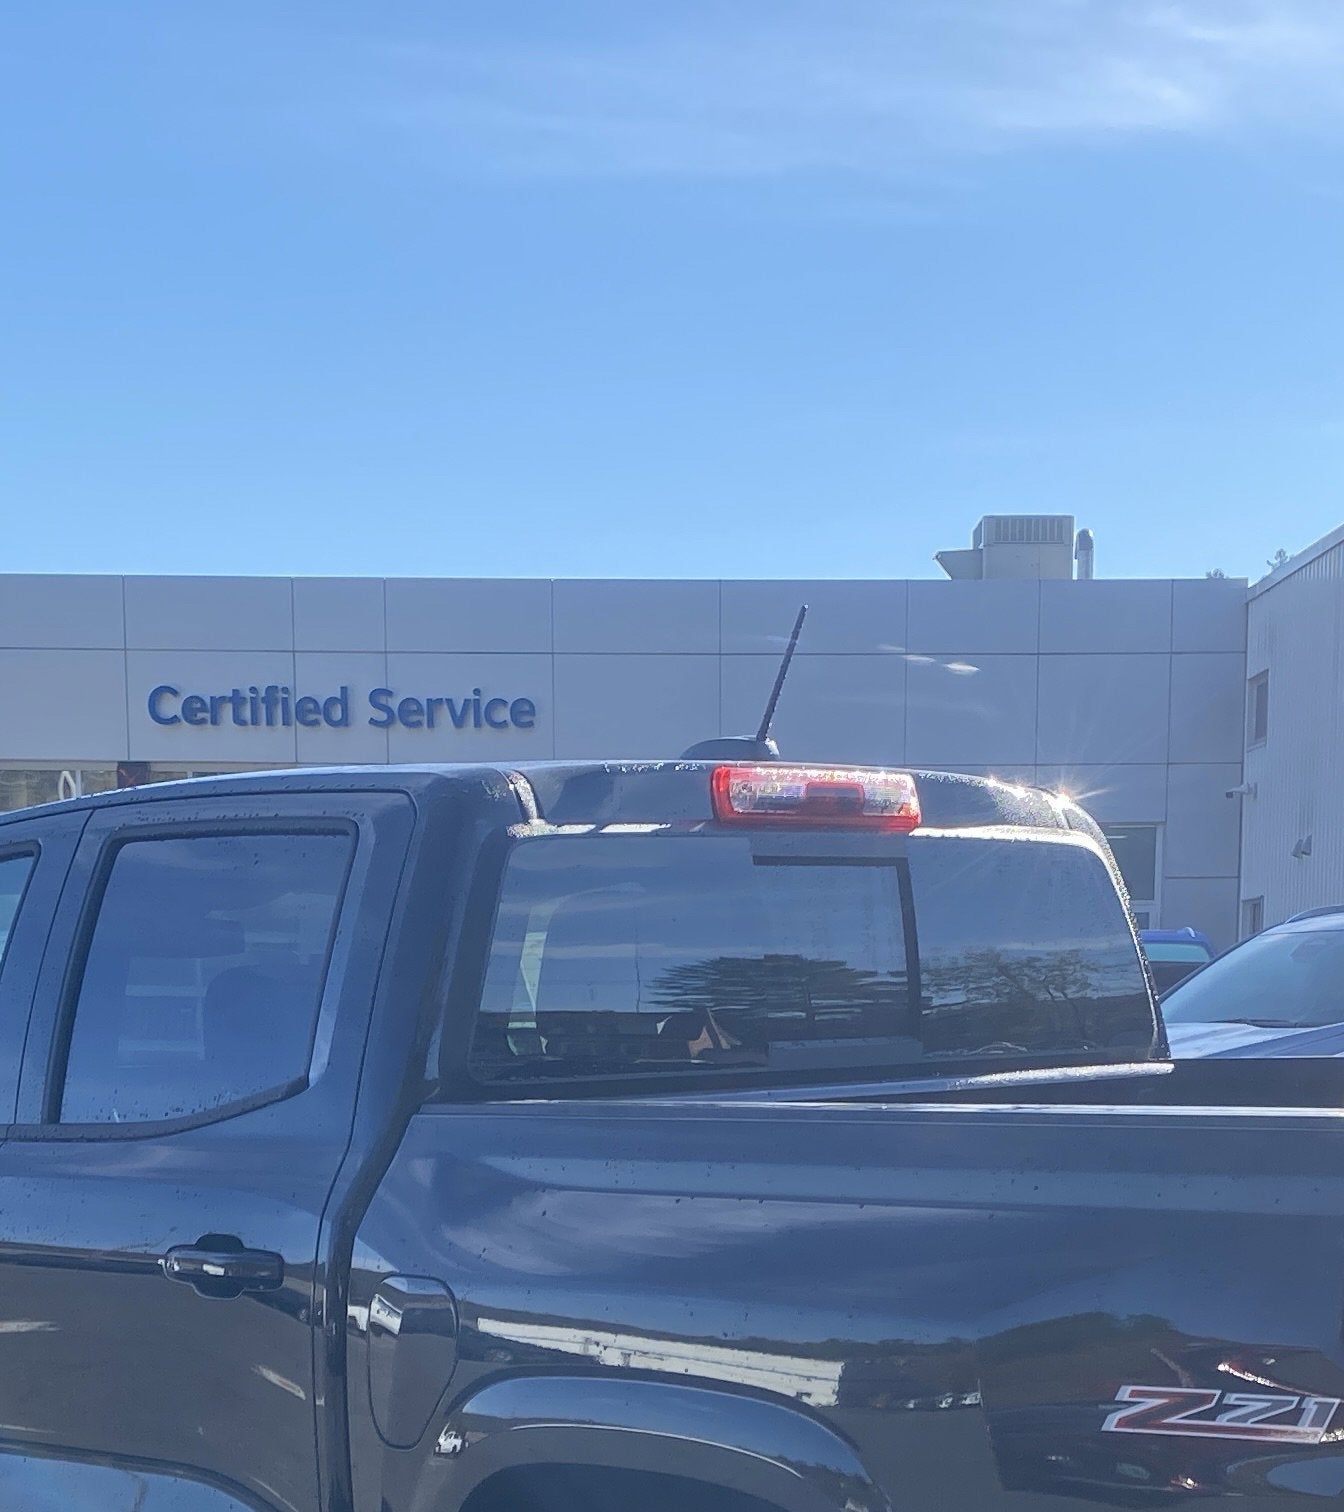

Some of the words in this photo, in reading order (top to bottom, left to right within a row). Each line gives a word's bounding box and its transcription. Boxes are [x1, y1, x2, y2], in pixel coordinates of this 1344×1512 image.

[147, 684, 350, 729] Certified
[368, 687, 537, 729] Service
[1101, 1384, 1341, 1444] Z71
